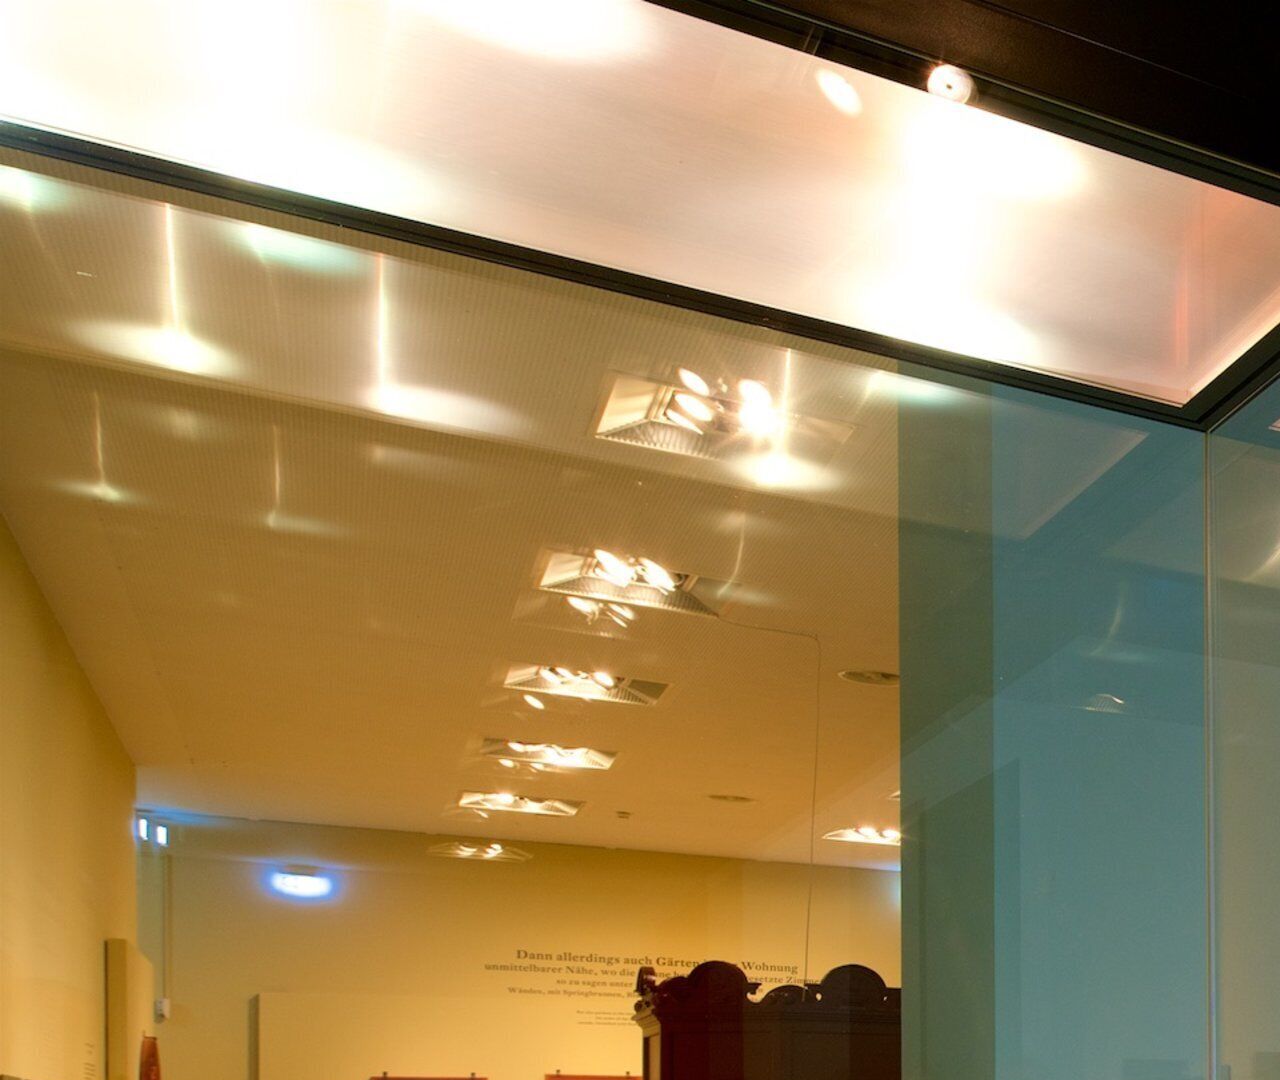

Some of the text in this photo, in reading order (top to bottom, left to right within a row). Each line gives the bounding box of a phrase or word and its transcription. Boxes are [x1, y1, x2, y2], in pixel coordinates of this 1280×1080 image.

[516, 949, 553, 961] Dann
[556, 952, 620, 966] allerdings
[623, 955, 653, 966] auch
[484, 962, 563, 974] unmittelbarer
[601, 969, 616, 977] wo
[619, 968, 635, 977] die
[741, 961, 799, 975] Wohnung
